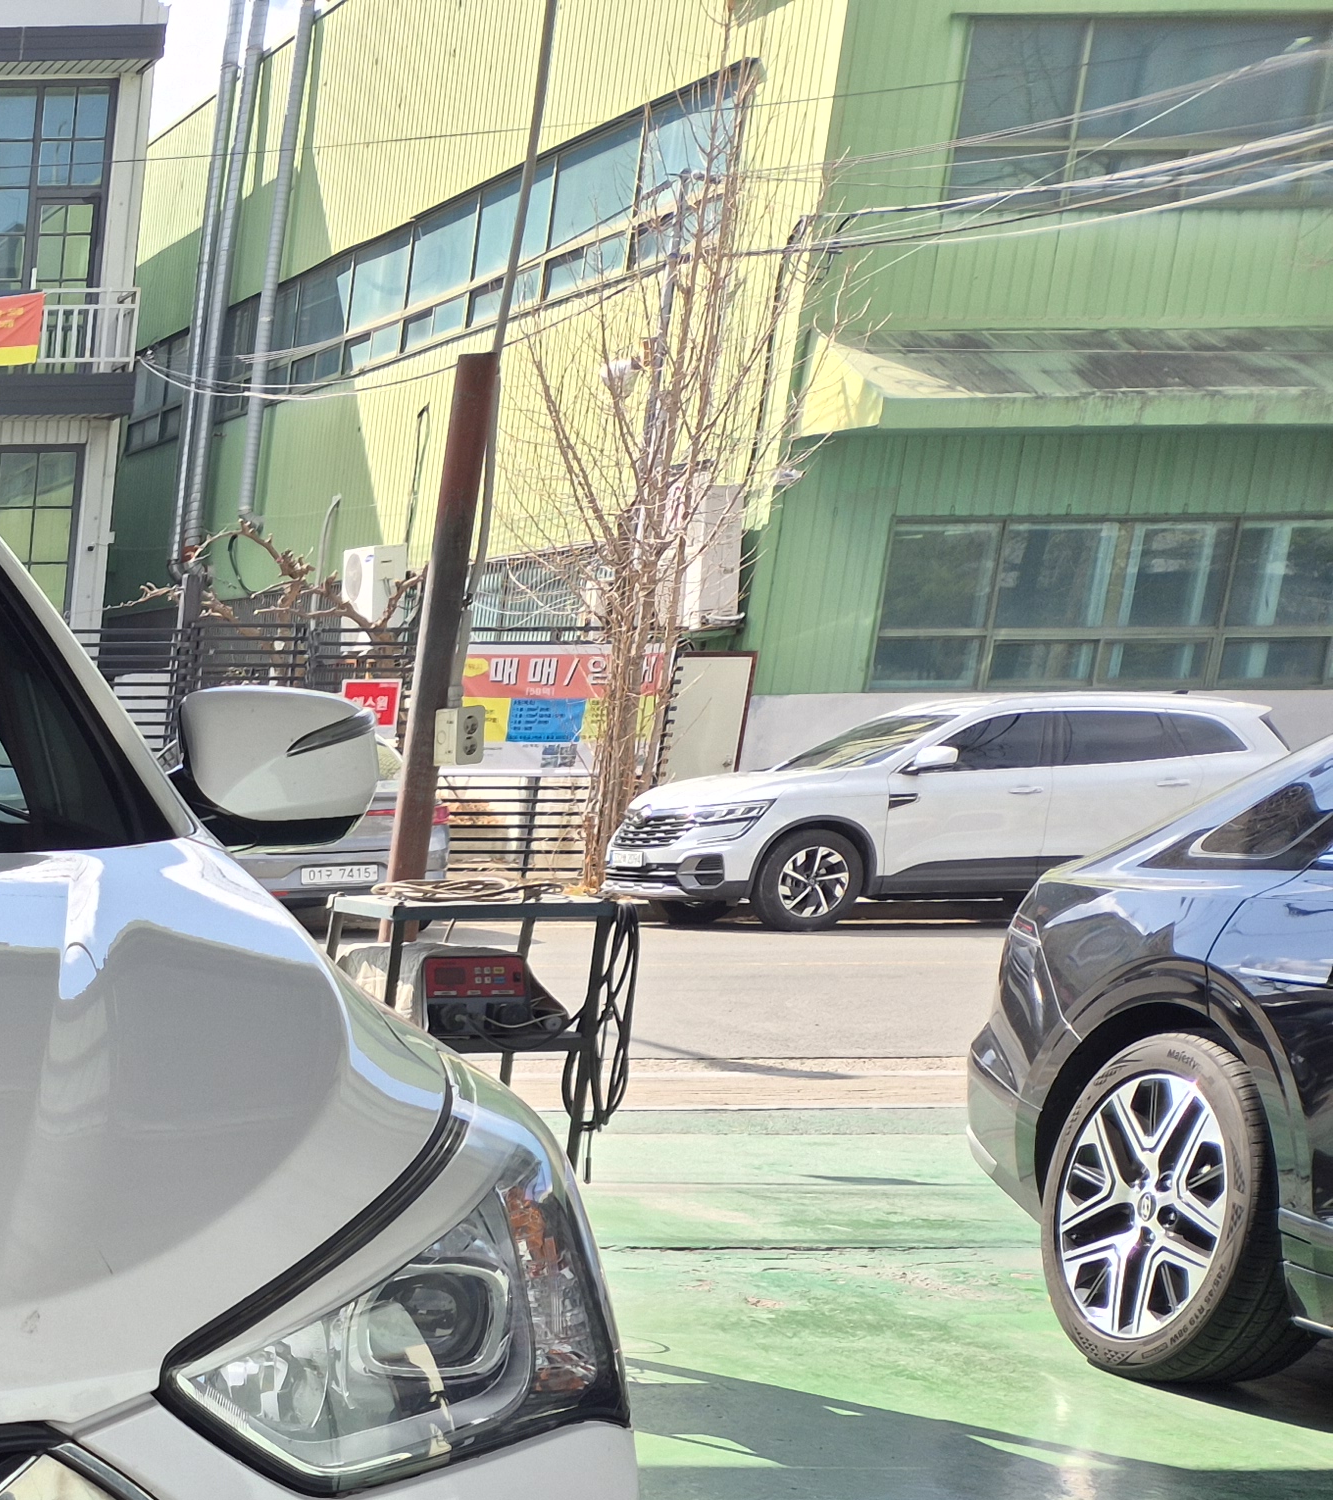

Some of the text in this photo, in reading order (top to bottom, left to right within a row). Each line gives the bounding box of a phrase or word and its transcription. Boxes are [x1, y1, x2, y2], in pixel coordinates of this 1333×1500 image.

[308, 867, 371, 881] 01구 7415
[1166, 1048, 1199, 1071] Majesty
[1204, 1263, 1226, 1306] 245/45
[1169, 1304, 1205, 1346] R19 98W
